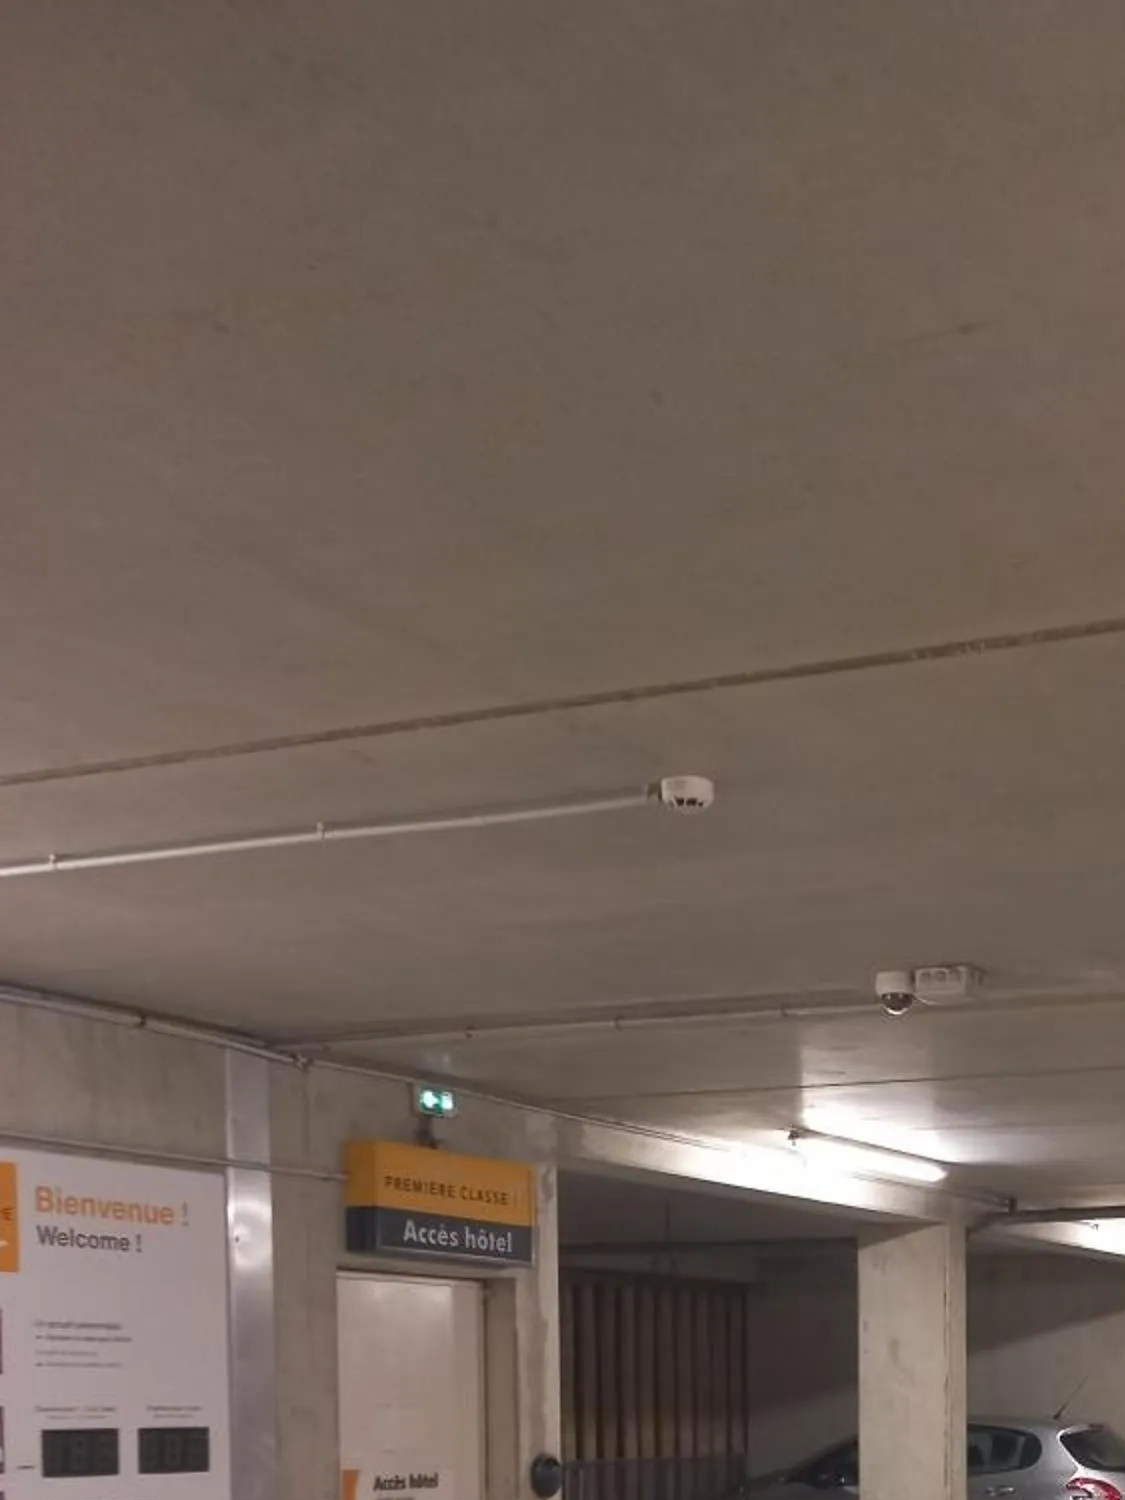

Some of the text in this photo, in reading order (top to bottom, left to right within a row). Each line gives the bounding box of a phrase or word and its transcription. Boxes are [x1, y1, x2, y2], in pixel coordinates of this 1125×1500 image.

[35, 1184, 175, 1226] Bienvenue
[459, 1185, 509, 1206] CLASSE
[35, 1224, 143, 1253] Welcome !
[403, 1218, 513, 1253] Accès hôtel
